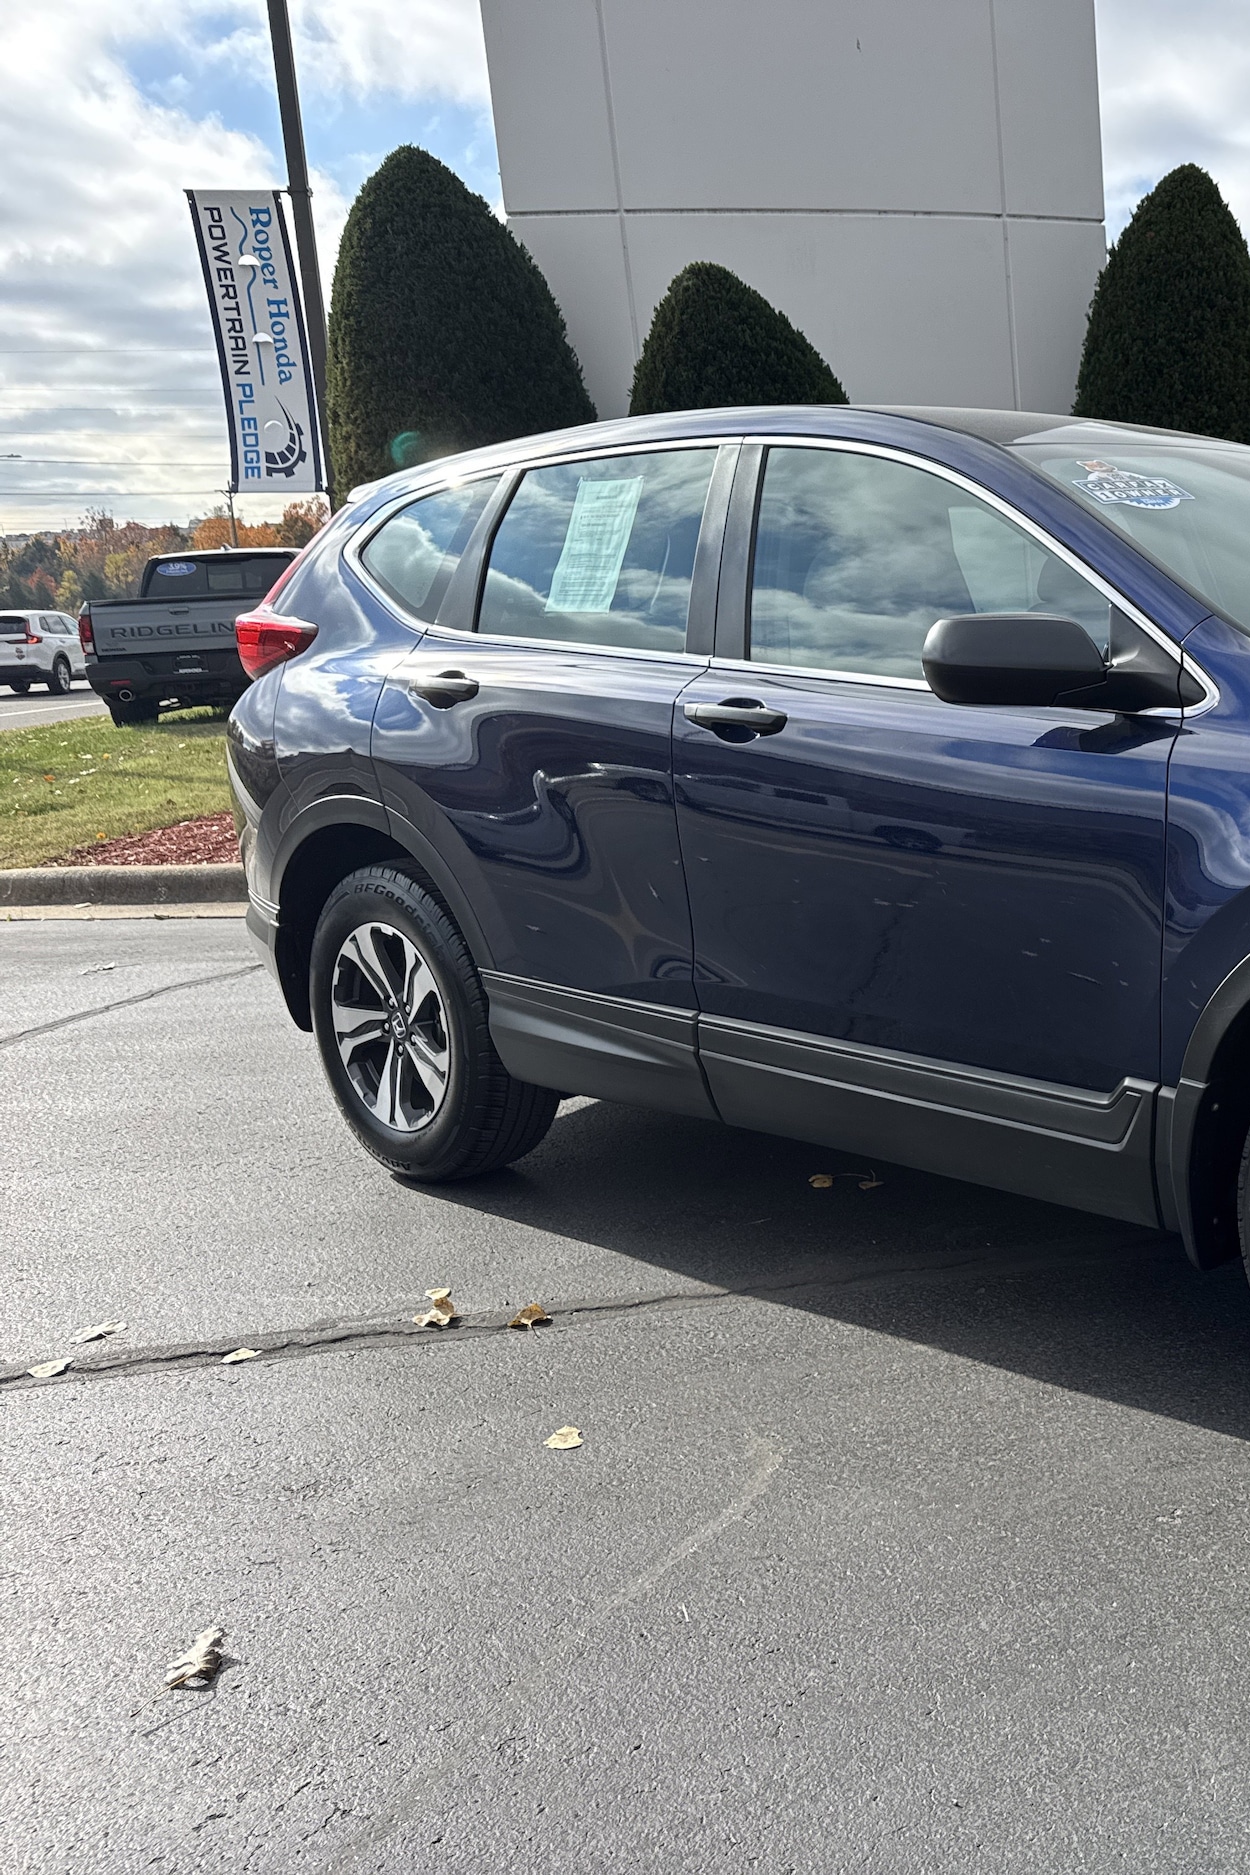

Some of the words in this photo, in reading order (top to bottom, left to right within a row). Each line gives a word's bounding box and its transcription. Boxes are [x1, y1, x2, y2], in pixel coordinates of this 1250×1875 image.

[249, 206, 278, 289] Roper
[266, 298, 297, 385] Honda
[203, 206, 251, 375] POWERTRAIN
[236, 382, 262, 479] PLEDGE
[1086, 479, 1172, 491] CARFAX
[1114, 488, 1183, 499] OWNER
[110, 621, 235, 639] RIDGELIN
[353, 882, 446, 960] BFGoodrich
